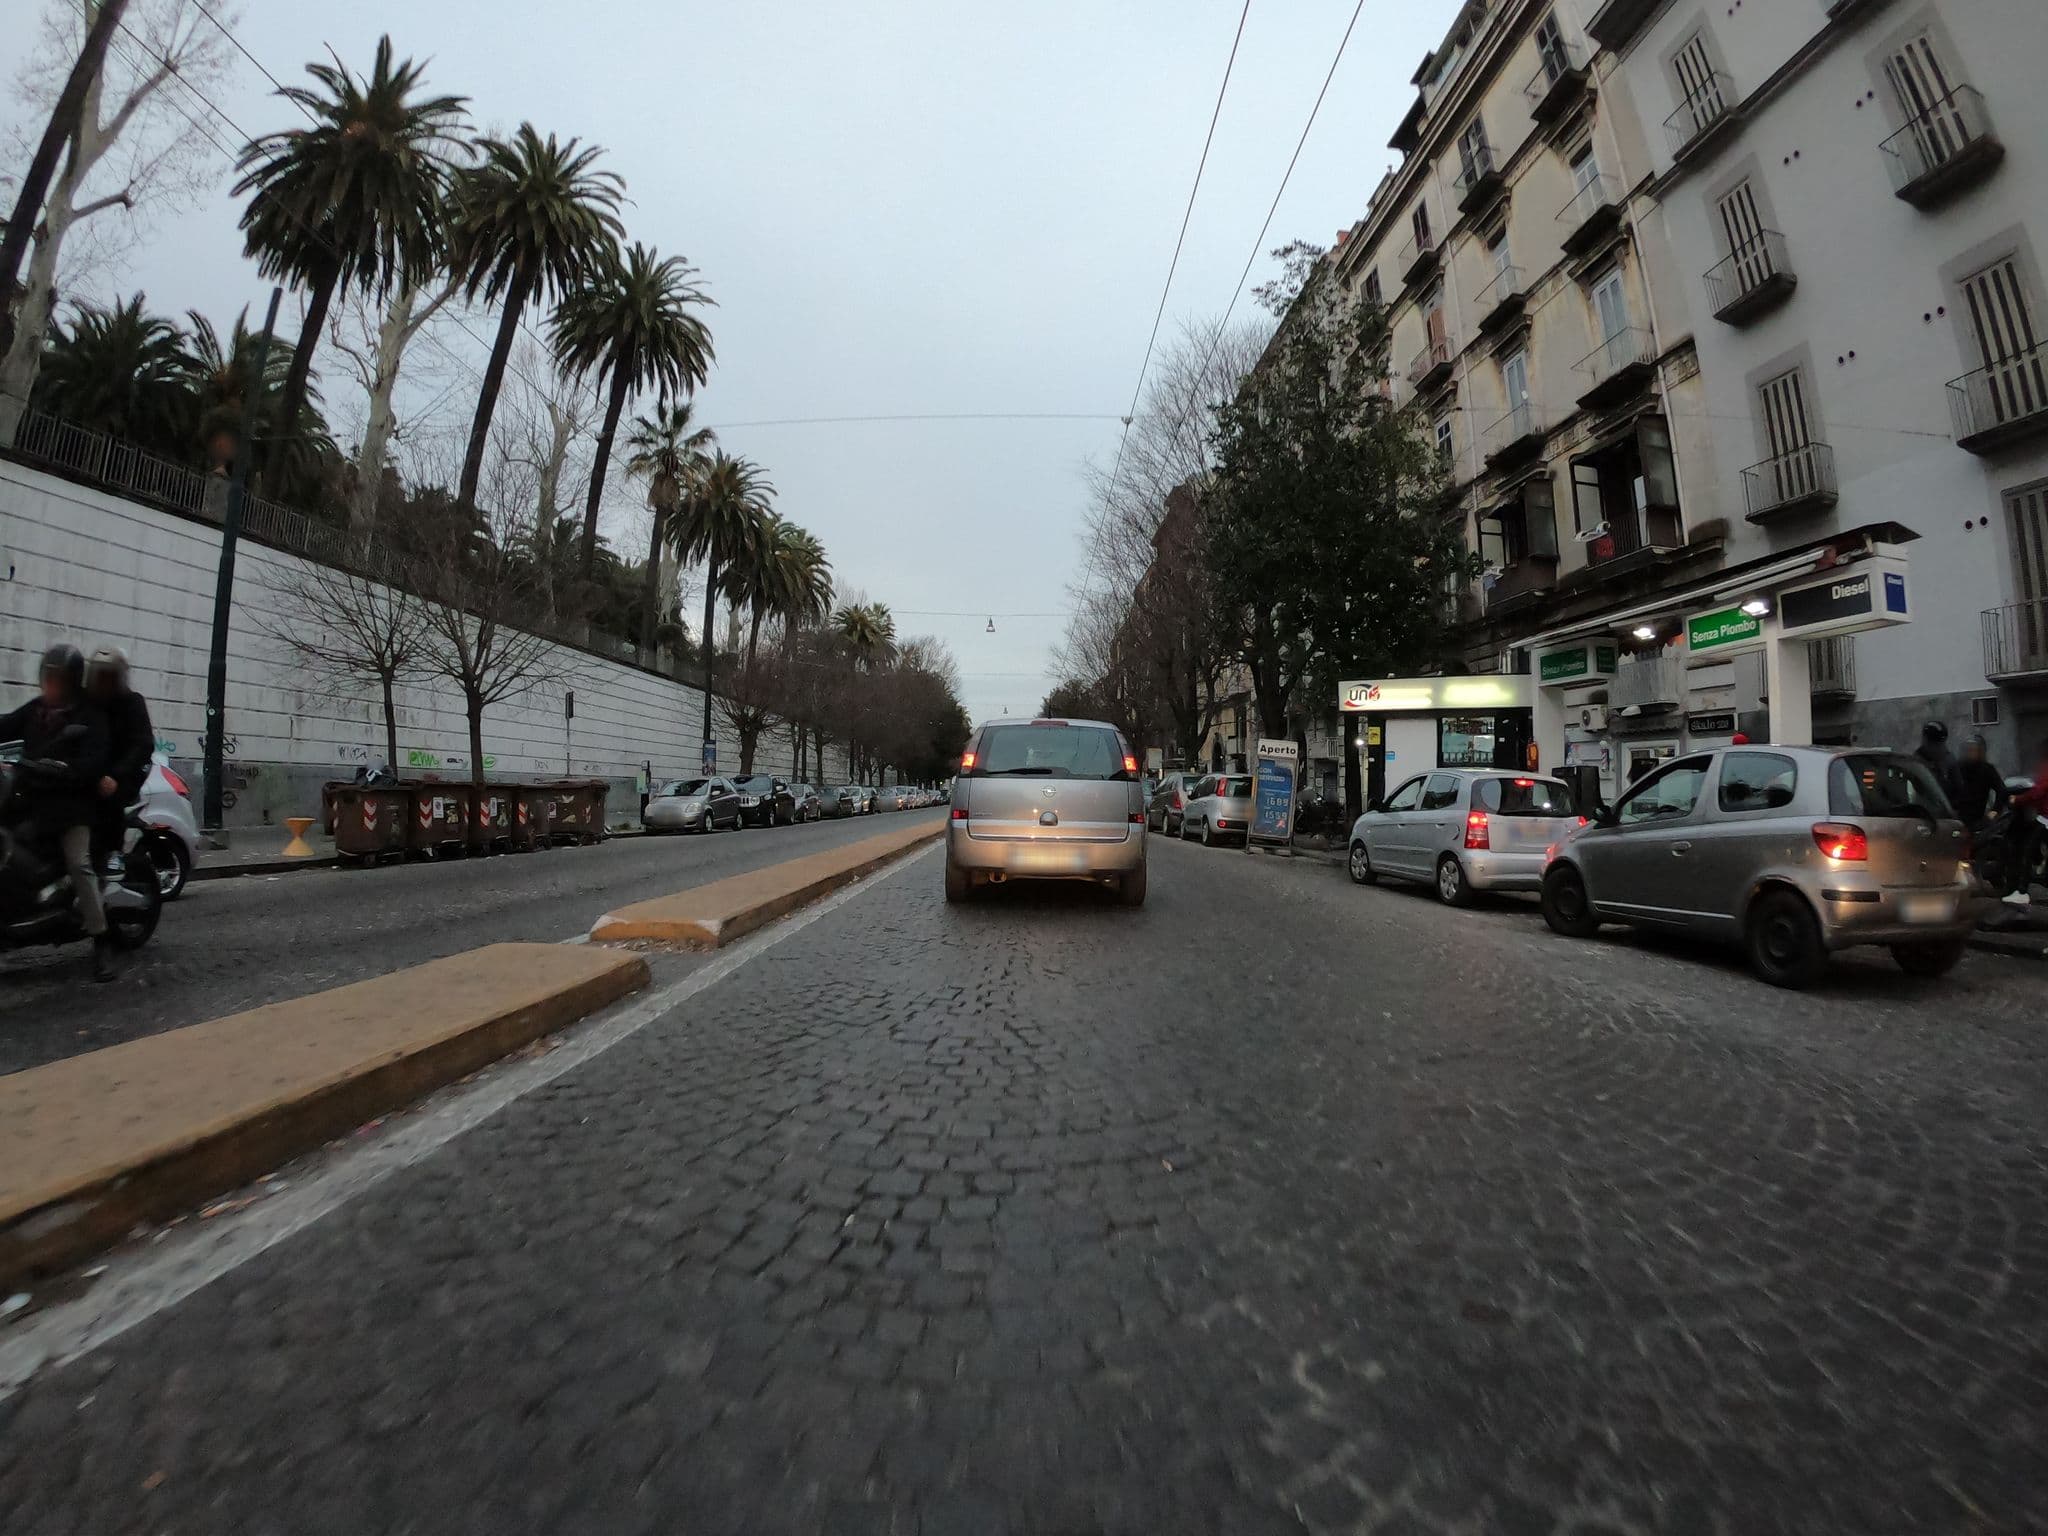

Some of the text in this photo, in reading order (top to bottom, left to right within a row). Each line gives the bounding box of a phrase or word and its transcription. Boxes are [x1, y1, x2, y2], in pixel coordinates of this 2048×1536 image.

[1832, 579, 1869, 600] Diesel
[1692, 620, 1757, 643] Senza Piombo
[1260, 744, 1297, 755] Aperto
